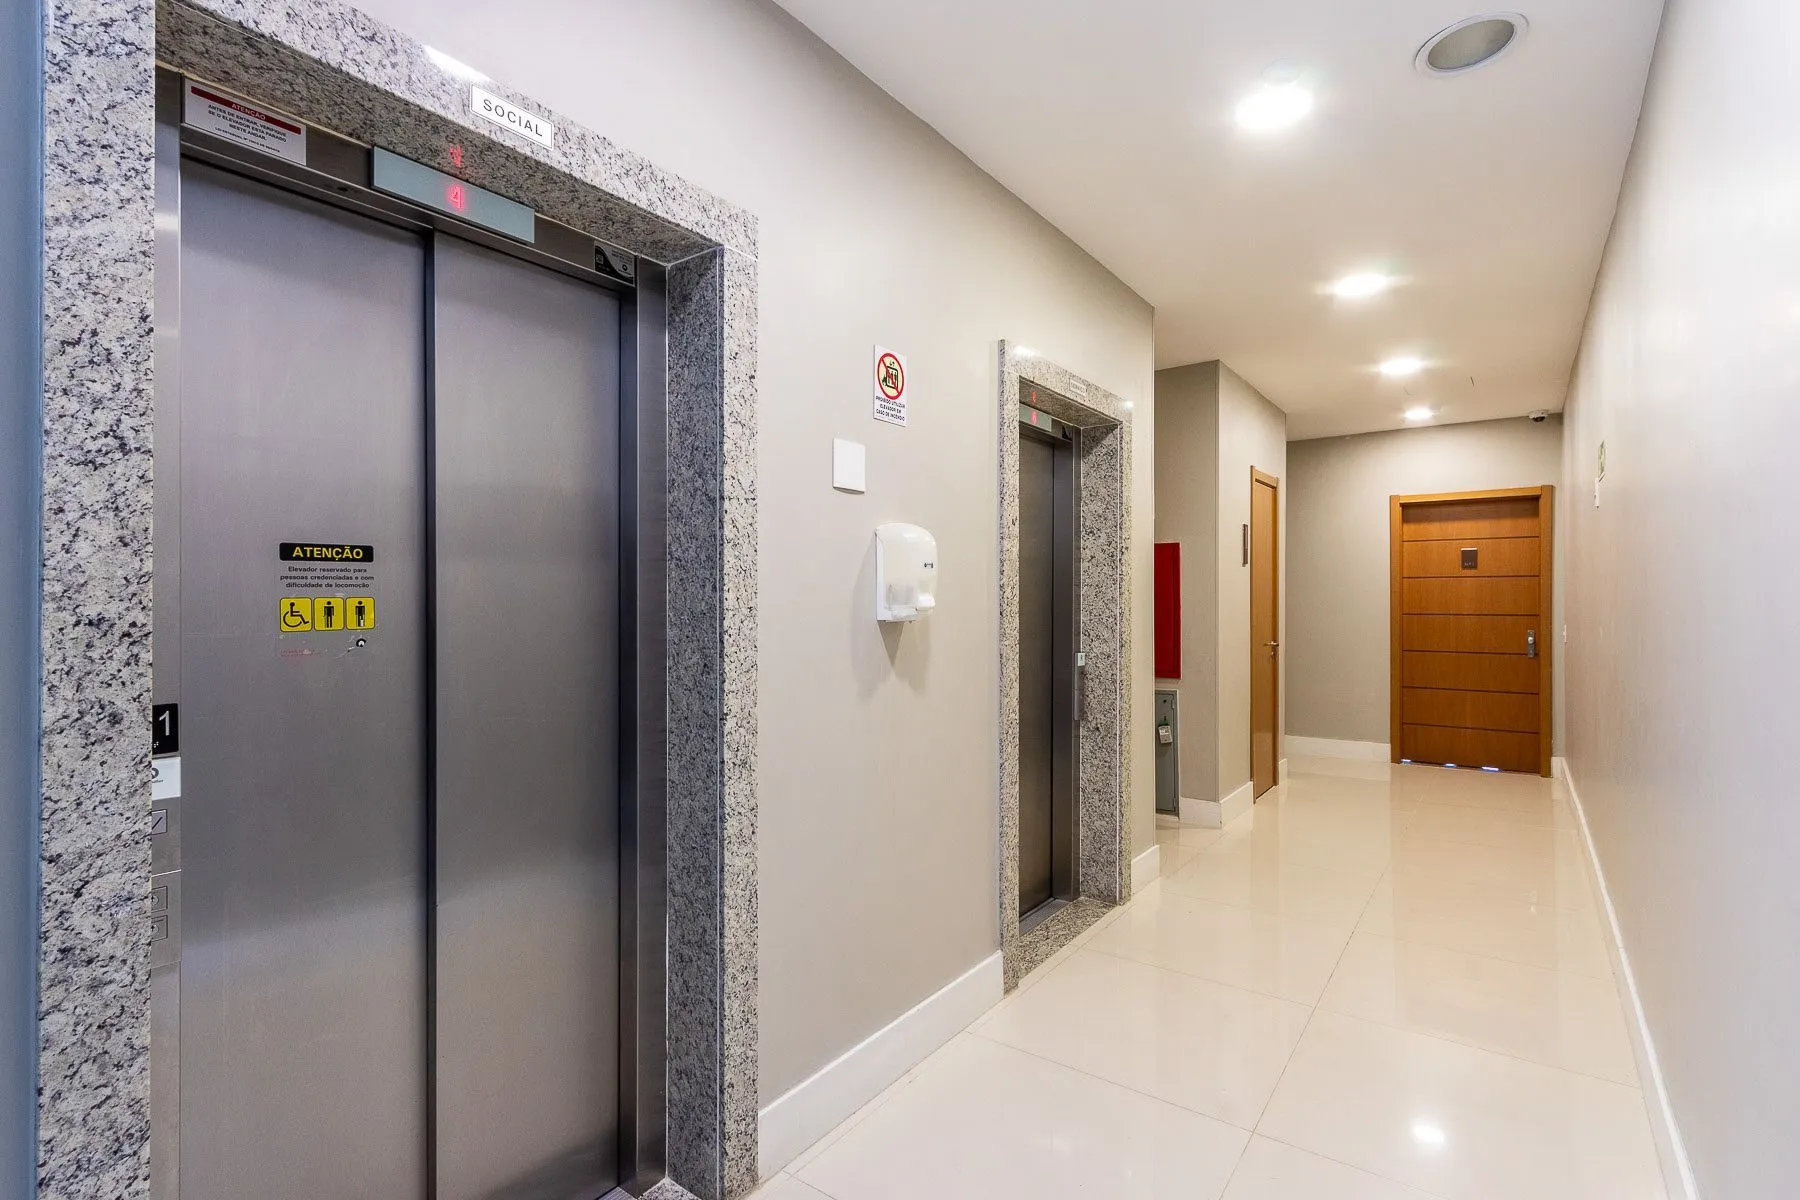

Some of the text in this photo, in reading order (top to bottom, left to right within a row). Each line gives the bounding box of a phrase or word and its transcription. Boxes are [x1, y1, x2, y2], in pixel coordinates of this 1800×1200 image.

[208, 104, 227, 115] ANTES
[483, 98, 543, 137] SOCIAL
[222, 114, 251, 130] ELEVADOR
[265, 130, 287, 143] PARADO
[229, 123, 247, 134] NESTE
[449, 186, 462, 210] 4
[292, 546, 363, 561] ATENÇÃO
